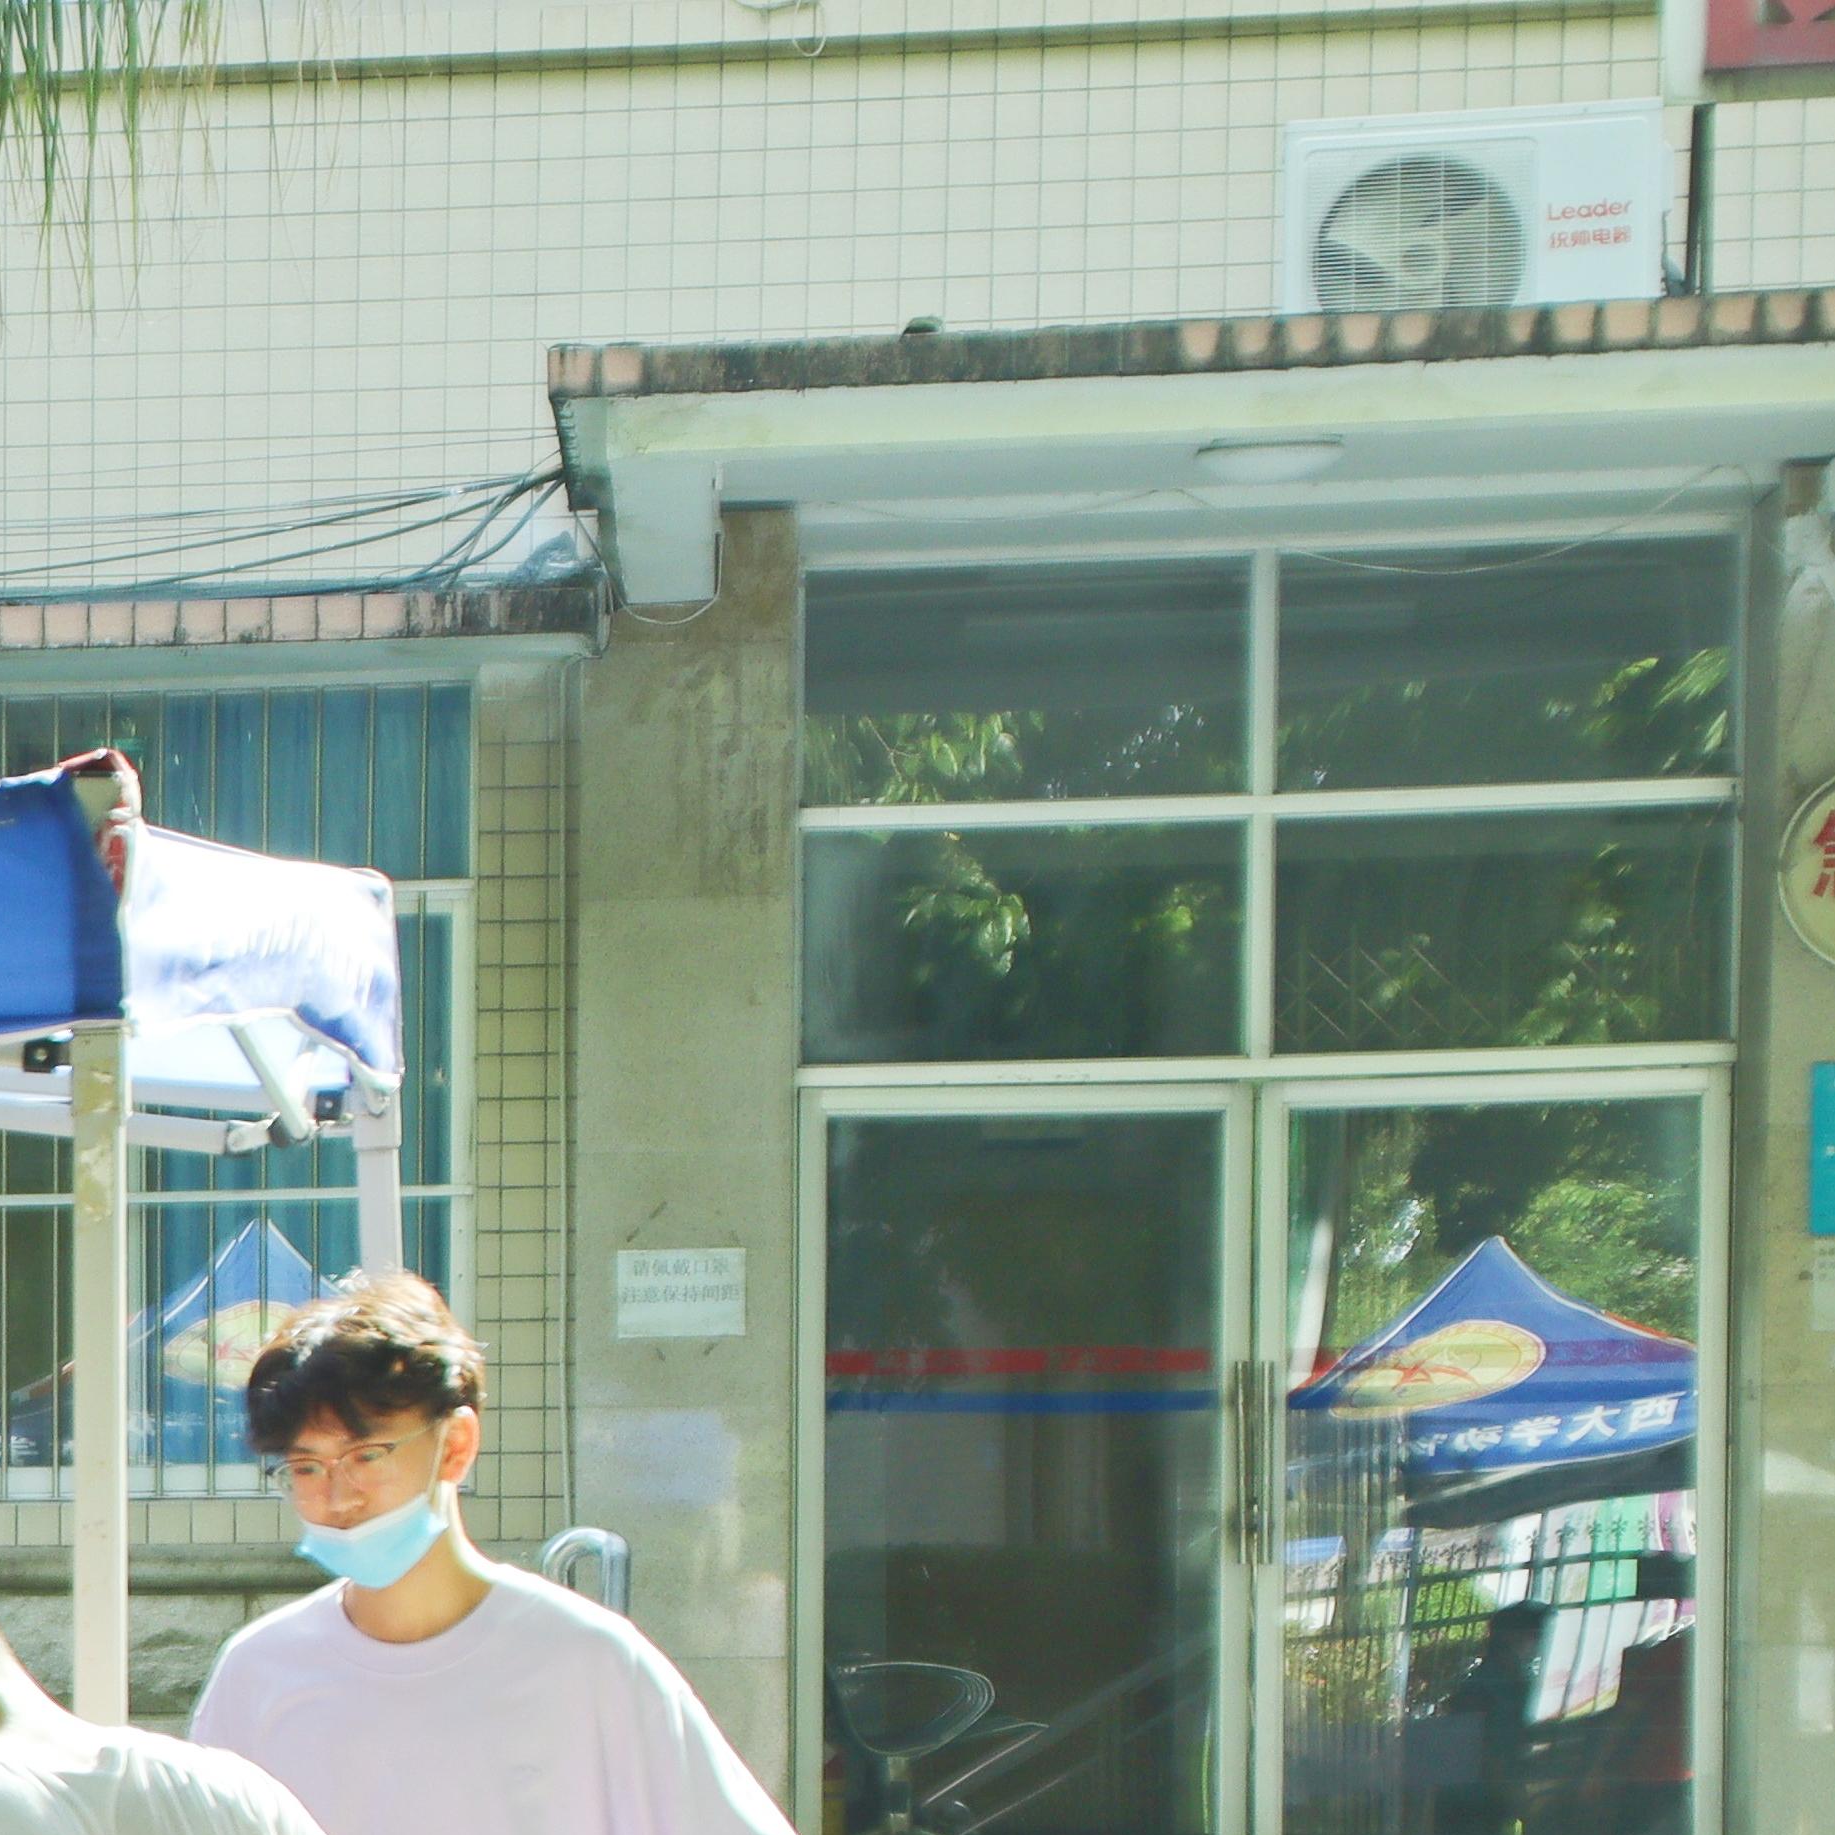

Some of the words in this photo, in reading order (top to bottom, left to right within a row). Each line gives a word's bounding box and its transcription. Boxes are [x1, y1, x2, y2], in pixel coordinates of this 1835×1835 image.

[1547, 200, 1632, 220] Leader
[1549, 226, 1632, 248] 统帅电器
